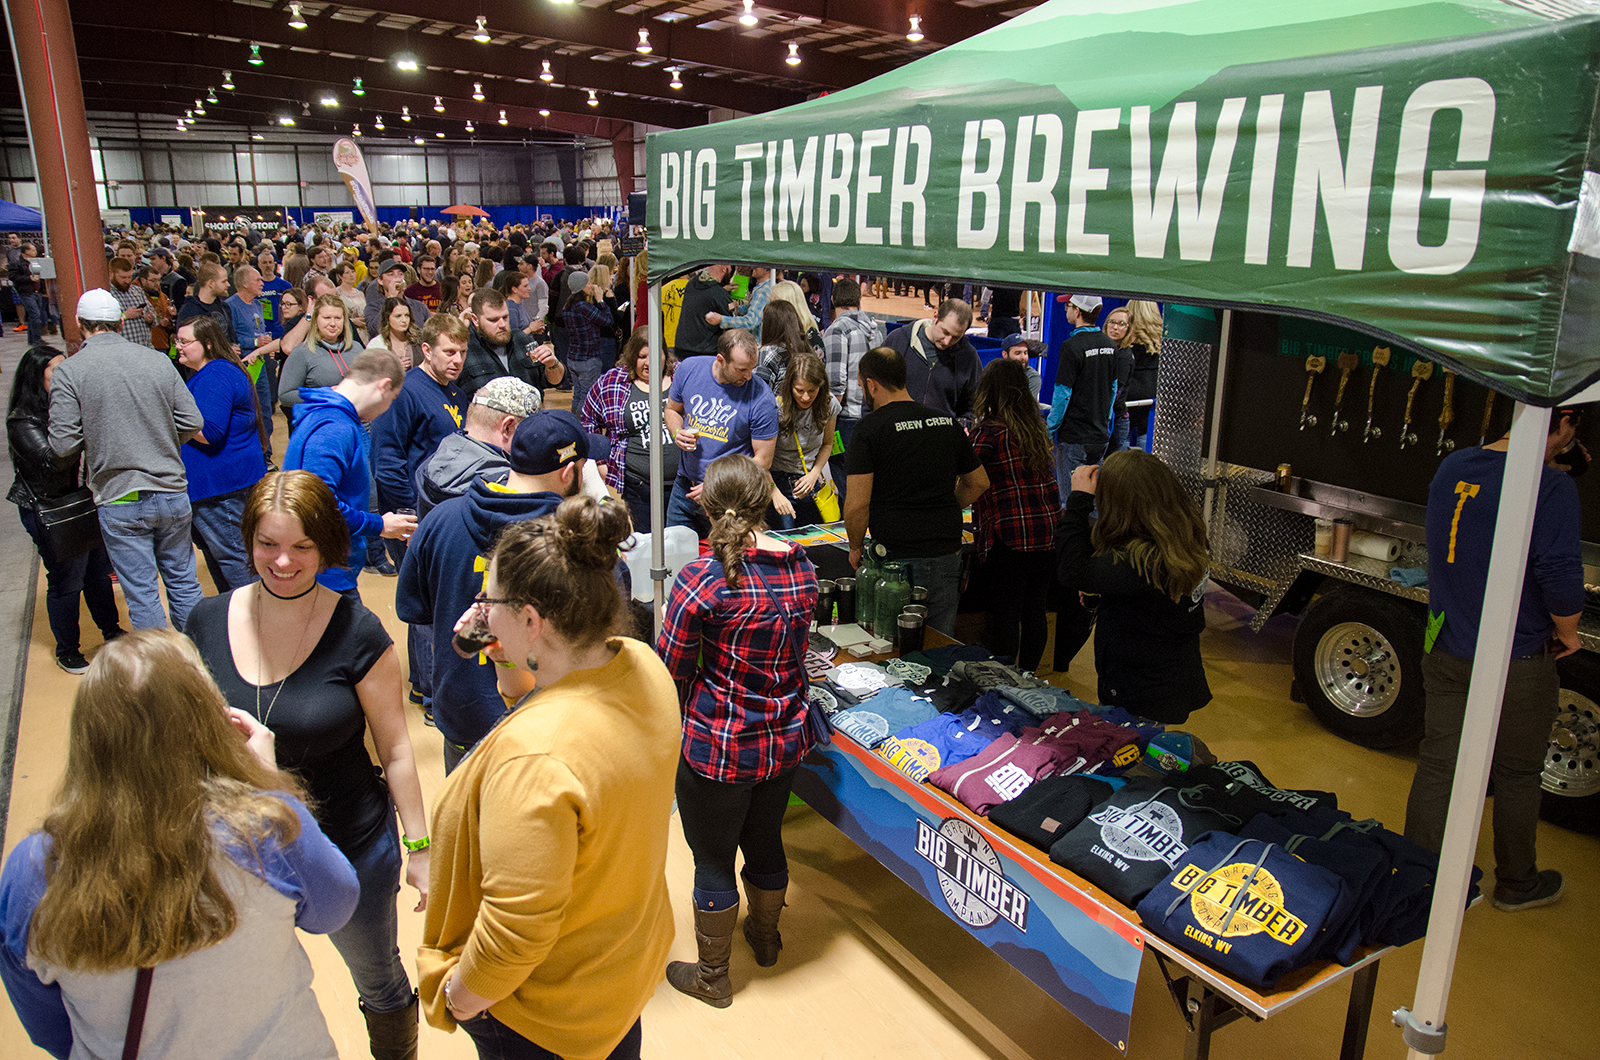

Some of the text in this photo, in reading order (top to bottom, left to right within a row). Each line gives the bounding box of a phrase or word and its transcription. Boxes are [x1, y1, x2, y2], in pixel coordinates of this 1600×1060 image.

[660, 148, 718, 240] BIG
[735, 124, 932, 247] TIMBER
[957, 77, 1496, 275] BREWING
[205, 222, 279, 230] SHORT STORY
[1282, 339, 1300, 355] BIG
[1306, 342, 1349, 361] TIMBE
[690, 394, 738, 426] Wild
[895, 416, 953, 432] BREW CREW
[945, 821, 997, 866] BREWING
[1095, 809, 1187, 866] BIG TIMBE
[1104, 828, 1148, 858] COMPANY
[1090, 844, 1131, 872] ELKINS, WV
[918, 823, 1026, 928] BIG TIMBER
[1178, 868, 1217, 895] BG
[1223, 866, 1279, 899] BREING
[941, 879, 989, 924] COMPANY
[1184, 924, 1233, 955] ELKINS, WV
